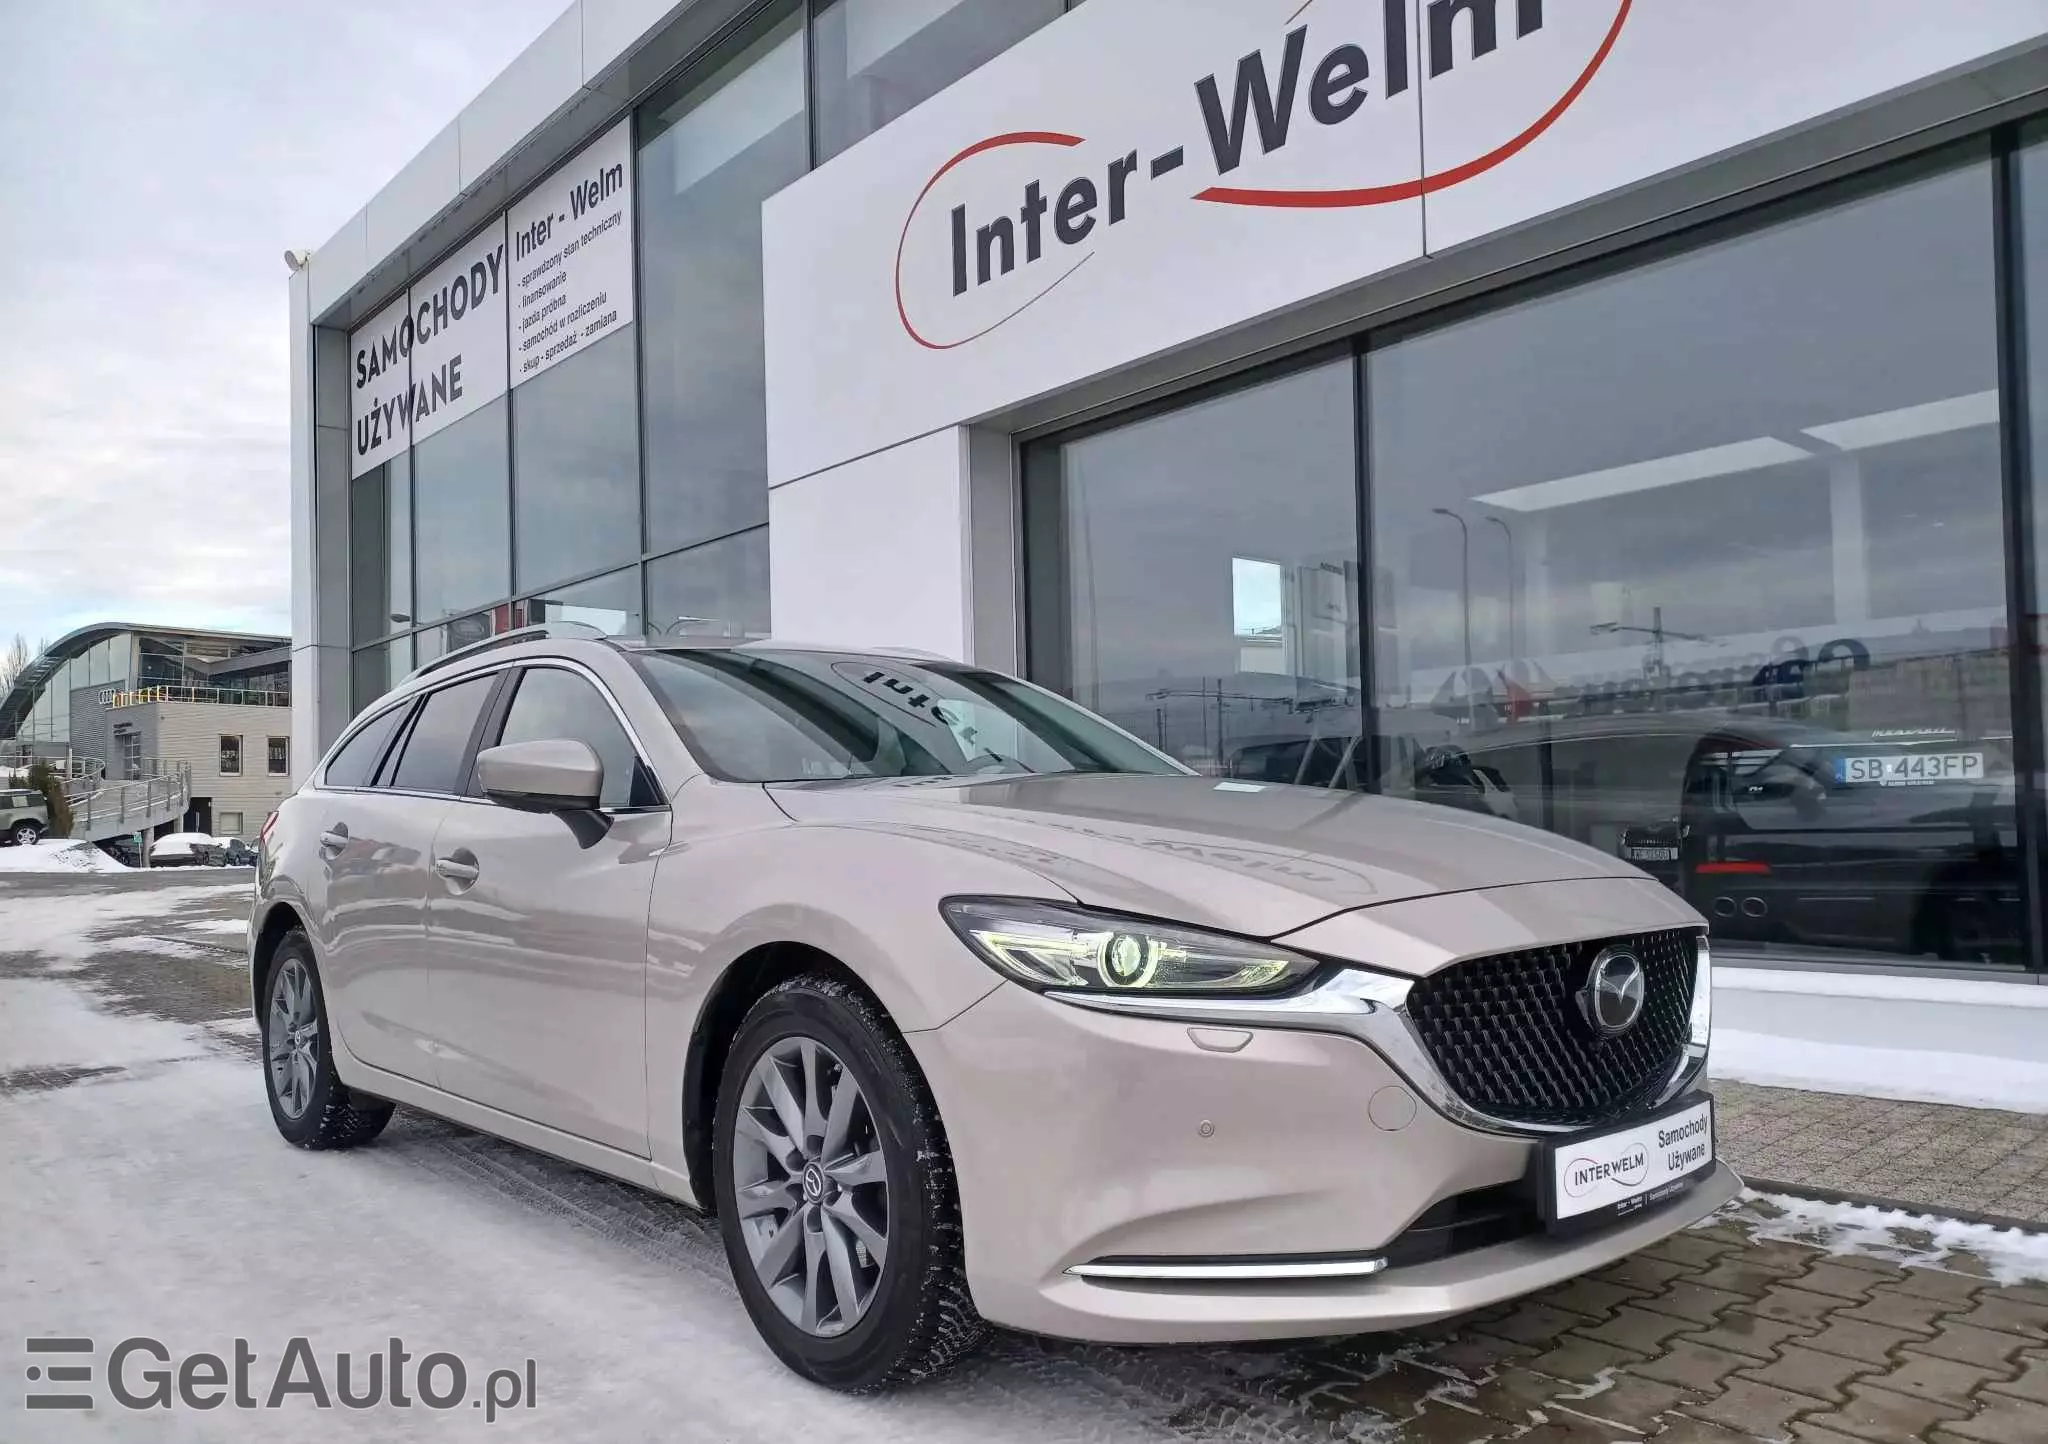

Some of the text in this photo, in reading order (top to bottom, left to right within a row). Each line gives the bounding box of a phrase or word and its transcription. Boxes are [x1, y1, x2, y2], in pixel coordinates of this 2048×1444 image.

[516, 214, 554, 261] Inter
[569, 163, 623, 220] Welm
[521, 210, 622, 288] sprawdzony stan techniczny
[356, 243, 504, 389] SAMOCHODY
[585, 309, 618, 337] zamiana
[357, 354, 463, 456] UŻYWANE
[1851, 754, 1978, 780] SB 443FP
[1658, 1113, 1709, 1148] Samochody
[1667, 1142, 1705, 1172] Używane
